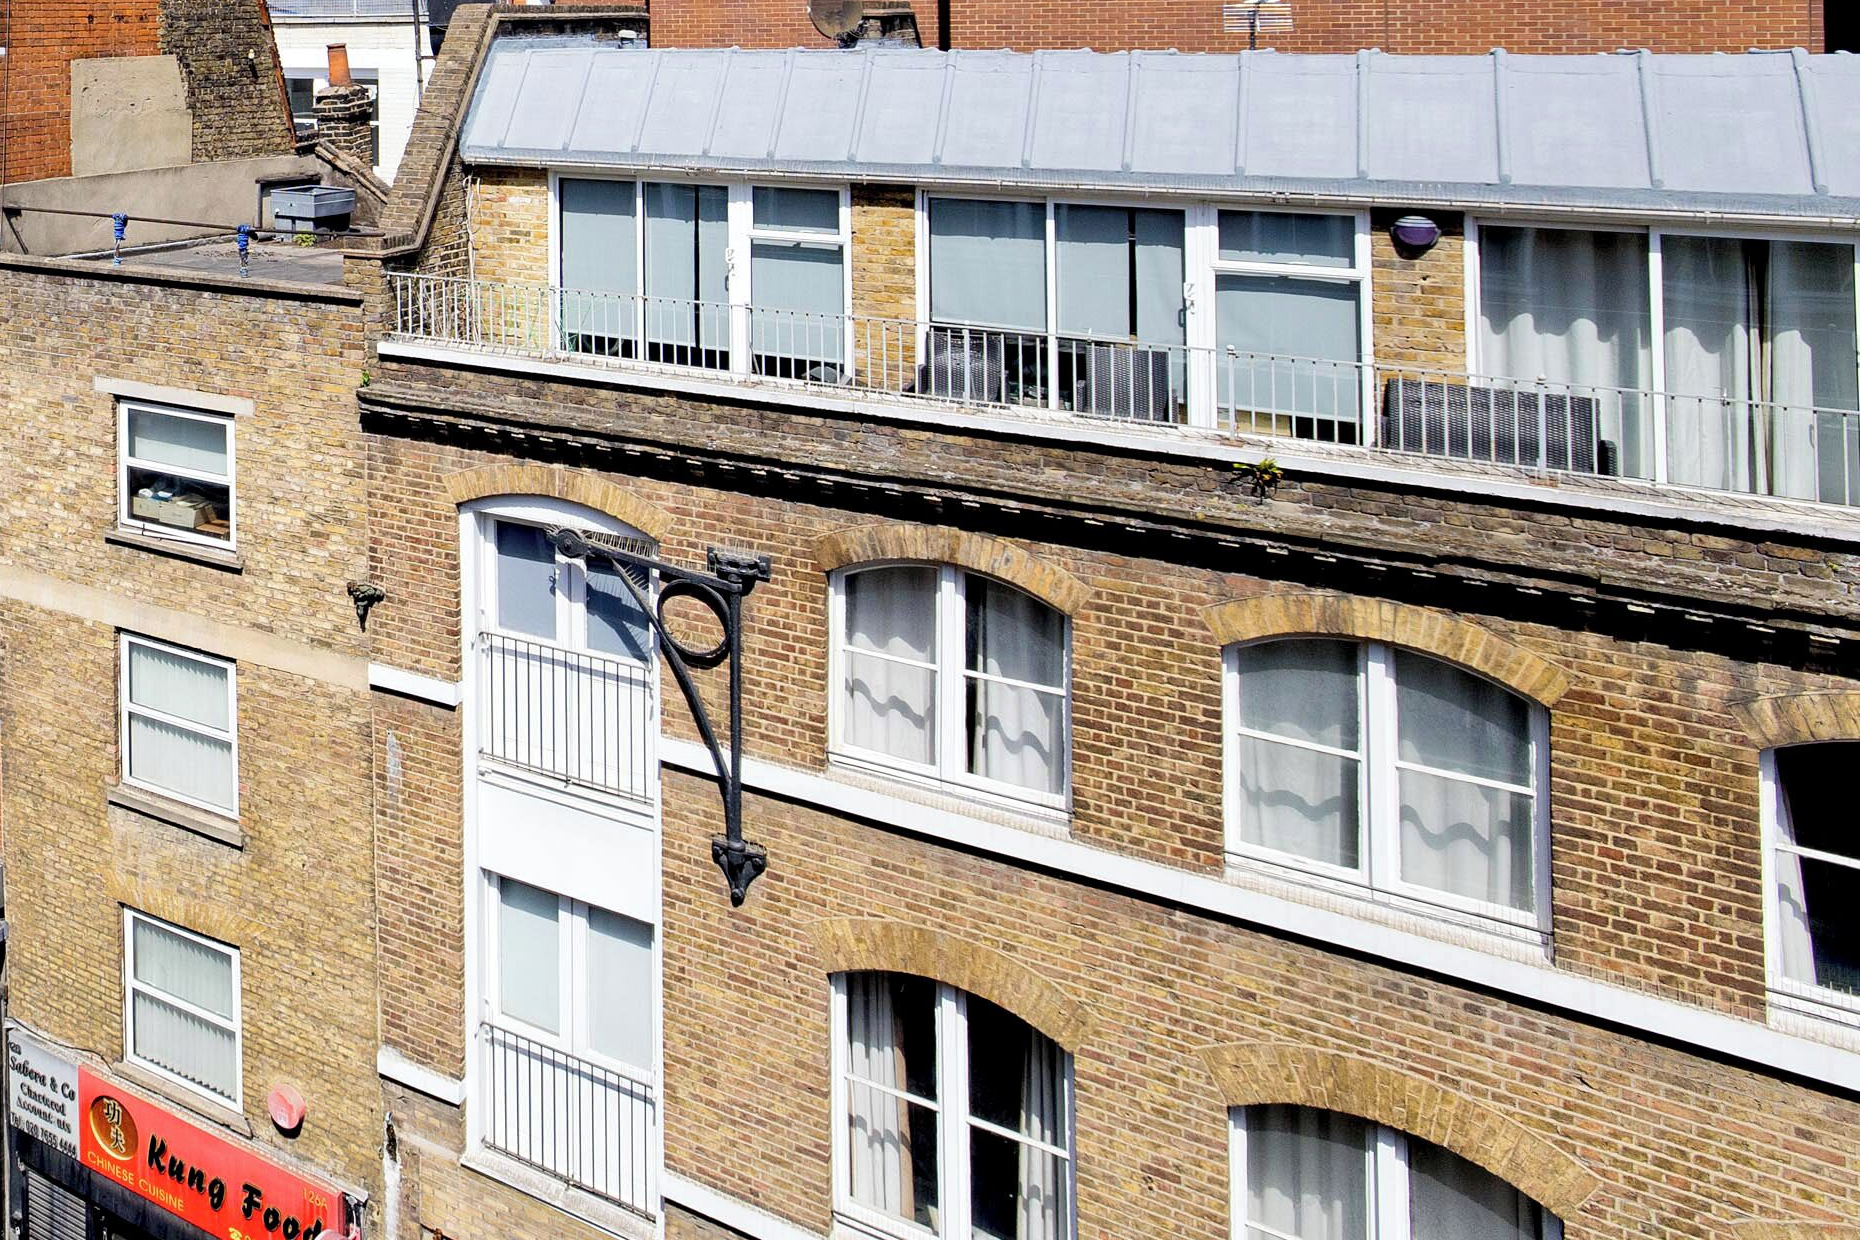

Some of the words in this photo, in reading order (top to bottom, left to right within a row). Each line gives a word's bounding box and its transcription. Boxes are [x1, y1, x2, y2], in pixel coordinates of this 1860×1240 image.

[9, 1055, 47, 1087] Sabera
[49, 1076, 58, 1094] &
[61, 1082, 76, 1101] Co
[16, 1095, 72, 1134] Accountnts
[20, 1082, 66, 1117] Chartered
[25, 1120, 39, 1138] 020
[102, 1097, 126, 1154] 功夫
[87, 1150, 135, 1186] CHINESE
[138, 1178, 185, 1211] CUISINE
[147, 1132, 227, 1212] Kung
[302, 1188, 328, 1210] 126A
